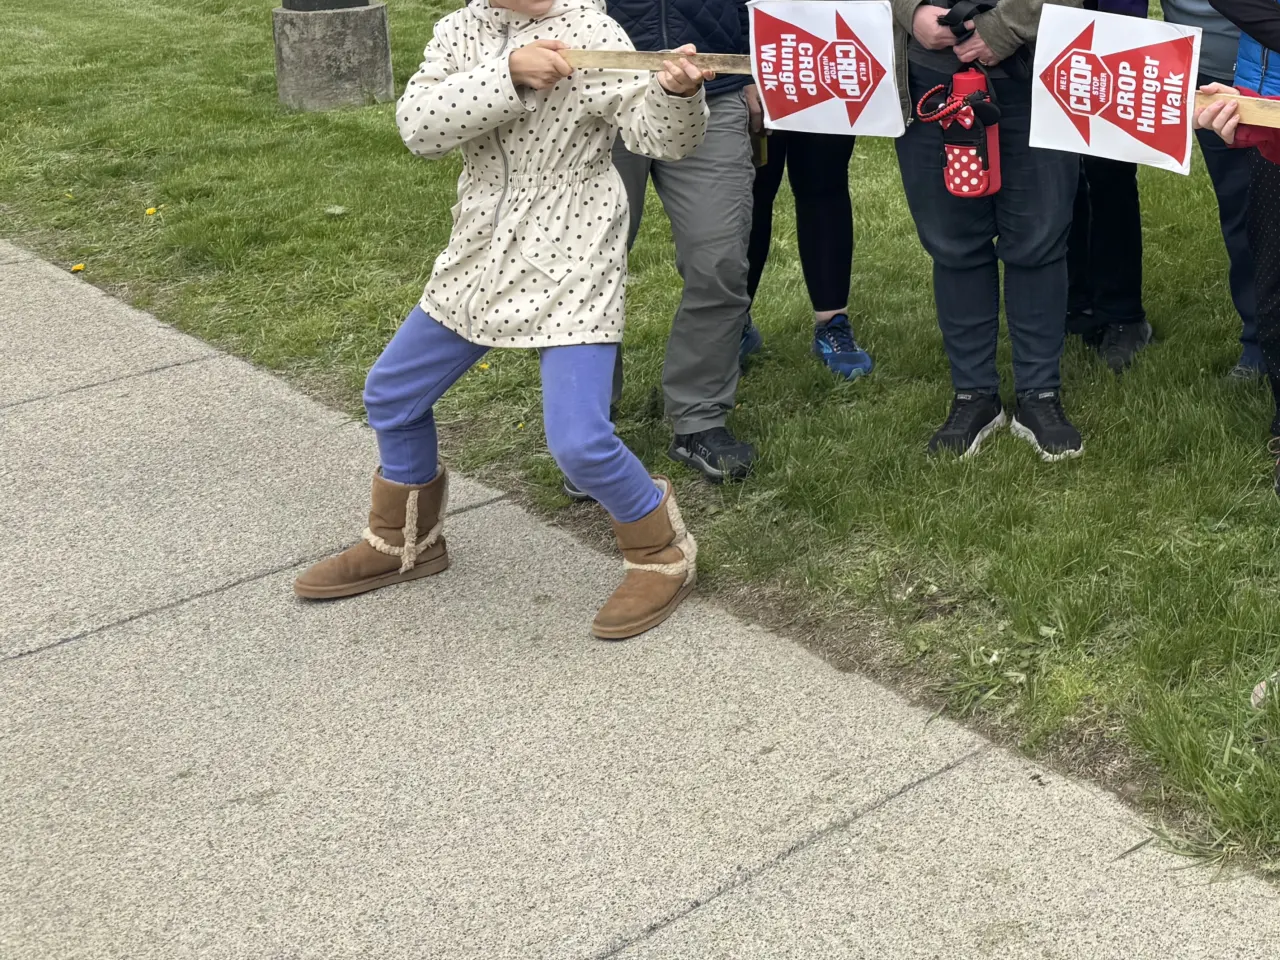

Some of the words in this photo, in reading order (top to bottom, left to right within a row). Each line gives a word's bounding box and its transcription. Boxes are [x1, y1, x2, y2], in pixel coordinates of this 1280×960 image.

[761, 43, 778, 91] Walk
[779, 34, 798, 103] Hunger
[798, 43, 817, 96] CROP
[822, 56, 831, 84] HUNGER
[829, 62, 837, 79] STOP
[835, 44, 861, 96] CROP
[1069, 54, 1093, 112] CROP
[1099, 72, 1107, 103] HUNGER
[1116, 61, 1137, 121] CROP
[1137, 56, 1160, 134] Hunger
[1161, 71, 1185, 125] Walk
